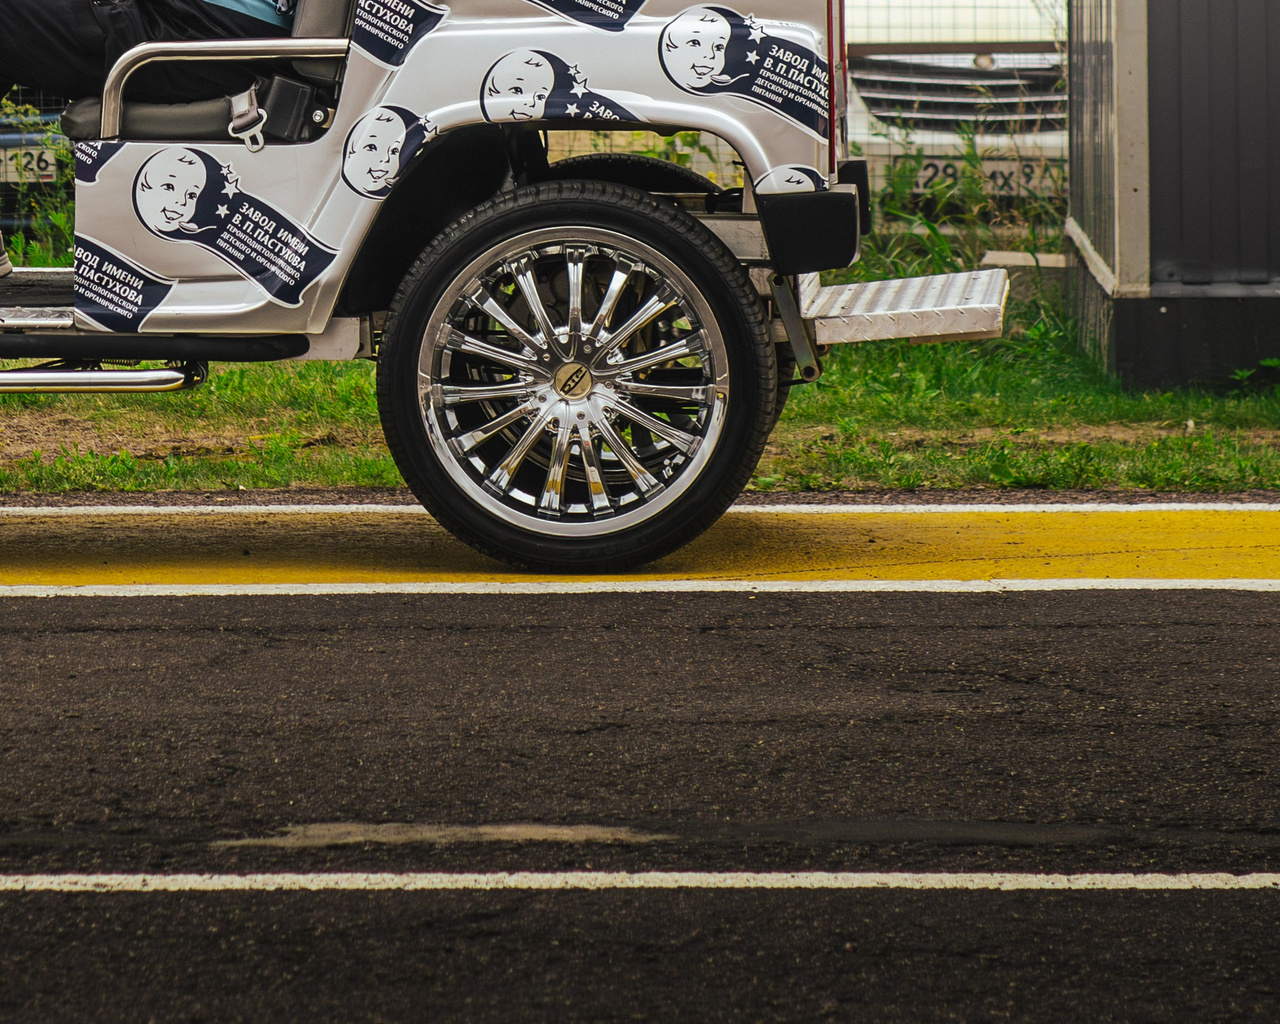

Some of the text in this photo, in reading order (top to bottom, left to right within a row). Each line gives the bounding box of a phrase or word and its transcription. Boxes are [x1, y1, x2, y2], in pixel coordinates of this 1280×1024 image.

[354, 17, 404, 50] ОРГАНИЧЕСКОГО
[763, 56, 774, 71] В.
[775, 62, 787, 76] П.
[768, 44, 810, 73] ЗАВОД
[751, 85, 783, 104] ПИТАНИЯ
[754, 77, 789, 96] ДЕТСКОГО
[788, 92, 795, 100] И
[231, 213, 307, 272] В. П. ПАСТУХОВА
[239, 202, 310, 256] ЗАВОД ИМЕНИ
[216, 238, 245, 261] ПИТАНИЯ
[220, 231, 295, 286] ДЕТСКОГО И ОРГАНИЧЕСКОГО
[74, 244, 144, 290] ВОД ИМЕНИ
[78, 264, 144, 306] ПАСТУХОВА
[78, 287, 85, 295] И
[84, 291, 133, 319] ОРГАНИЧЕСКОГО
